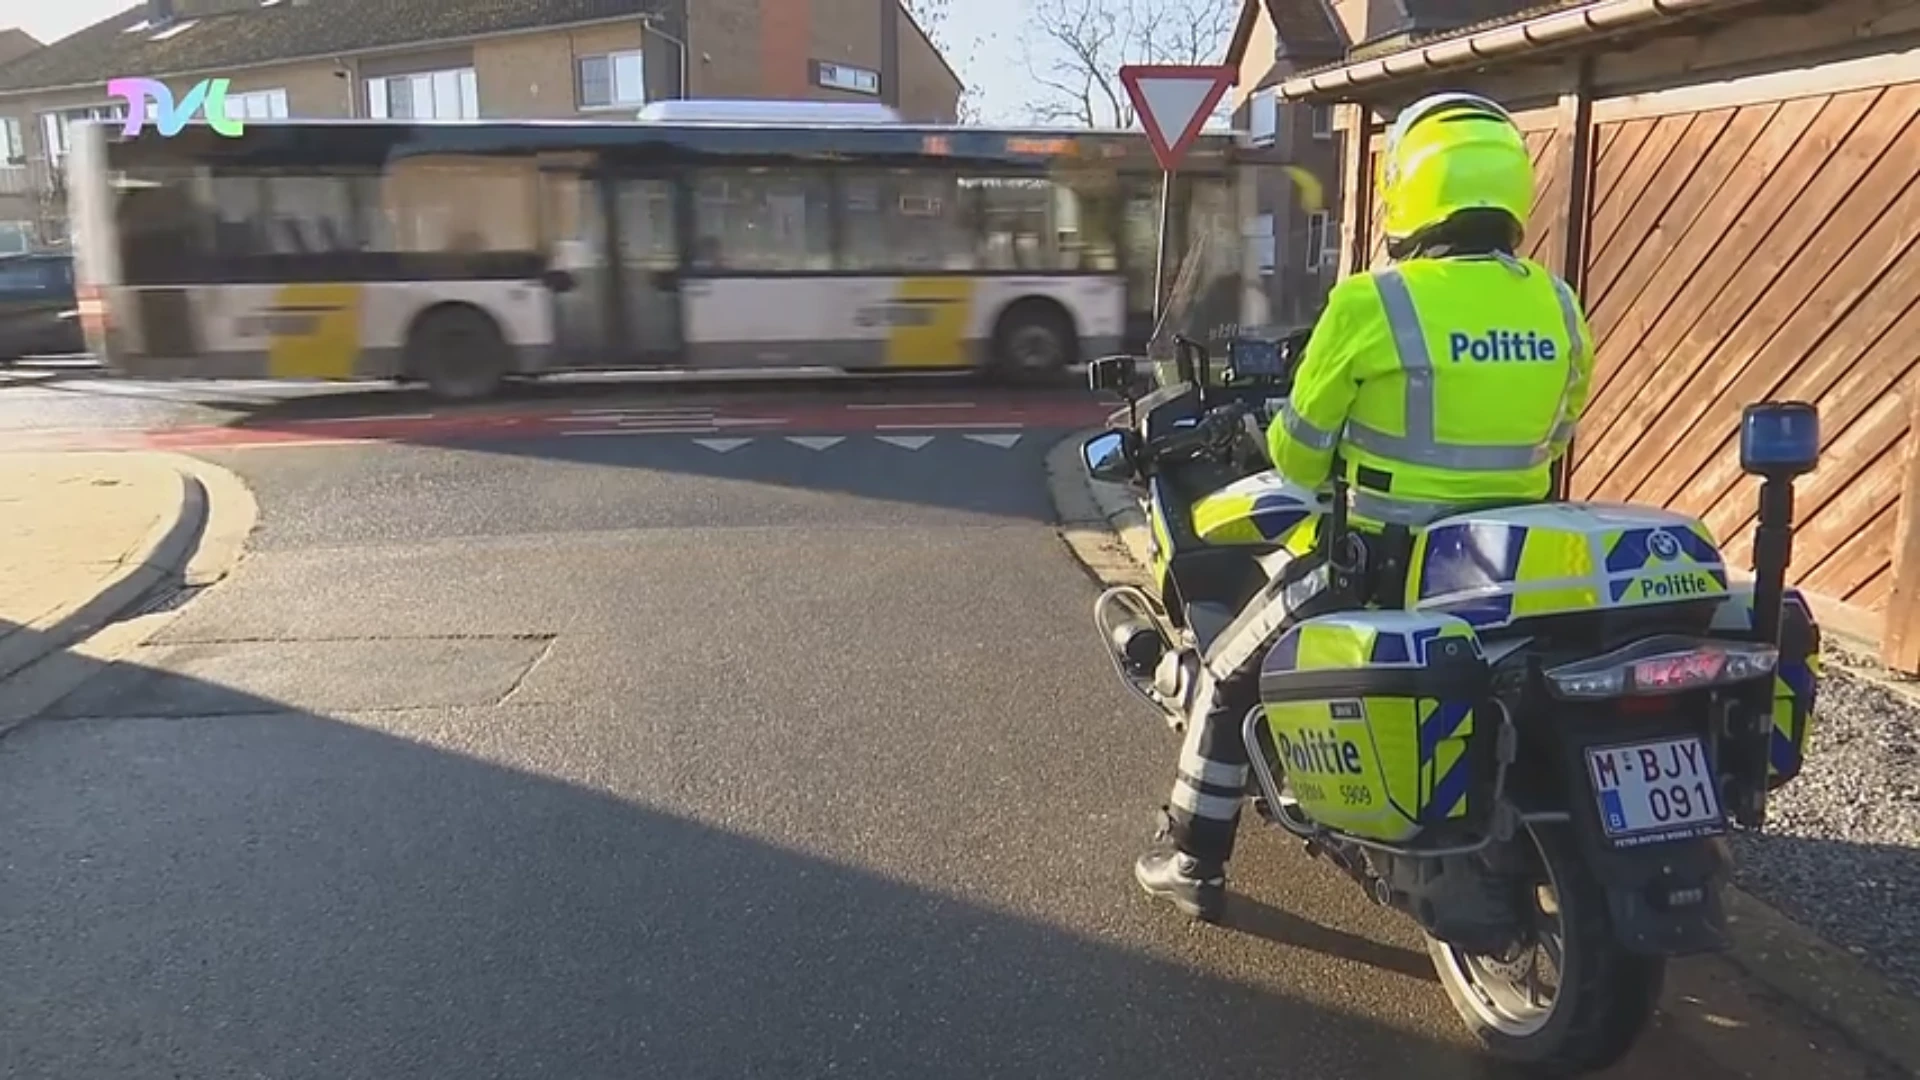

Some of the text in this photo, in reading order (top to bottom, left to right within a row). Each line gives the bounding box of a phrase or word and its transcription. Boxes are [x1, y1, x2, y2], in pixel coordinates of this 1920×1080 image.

[1449, 329, 1556, 362] Politie
[1641, 573, 1707, 598] Politie
[1278, 727, 1363, 774] Politie
[1339, 784, 1373, 806] 5909
[1649, 782, 1711, 822] 091
[1609, 812, 1622, 828] B
